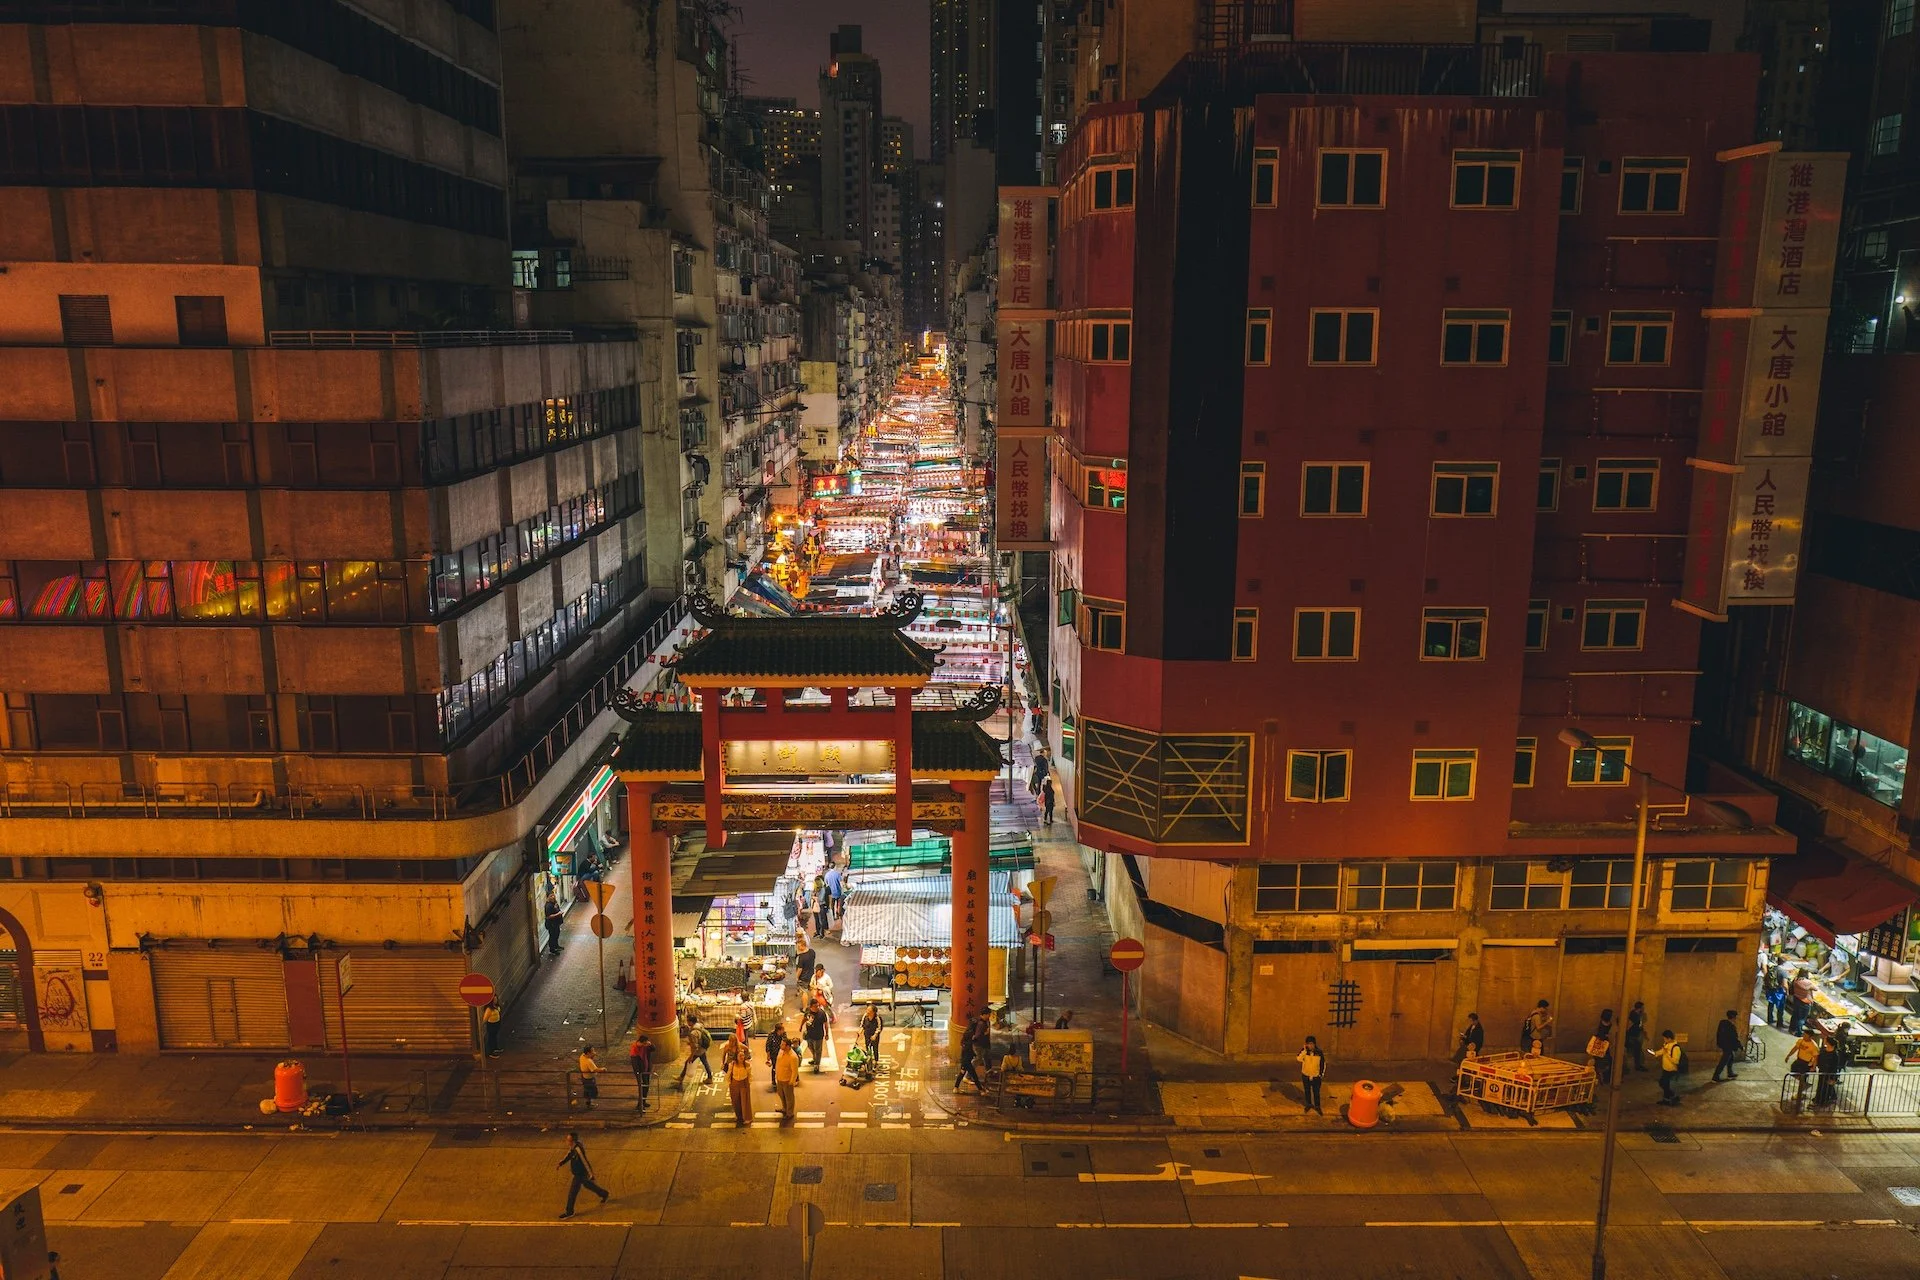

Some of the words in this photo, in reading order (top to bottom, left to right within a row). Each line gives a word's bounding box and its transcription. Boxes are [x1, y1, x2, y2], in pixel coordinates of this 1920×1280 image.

[1012, 199, 1033, 304] 維港灣酒店
[1777, 163, 1814, 296] 維港灣酒店
[1010, 326, 1031, 417] 大唐小館
[1761, 324, 1798, 437] 大唐小館
[1010, 439, 1030, 539] 人民幣找換
[1743, 468, 1777, 591] 人民幣找換
[88, 952, 104, 962] 22
[873, 1080, 890, 1106] LOOK
[894, 1067, 920, 1093] 望右
